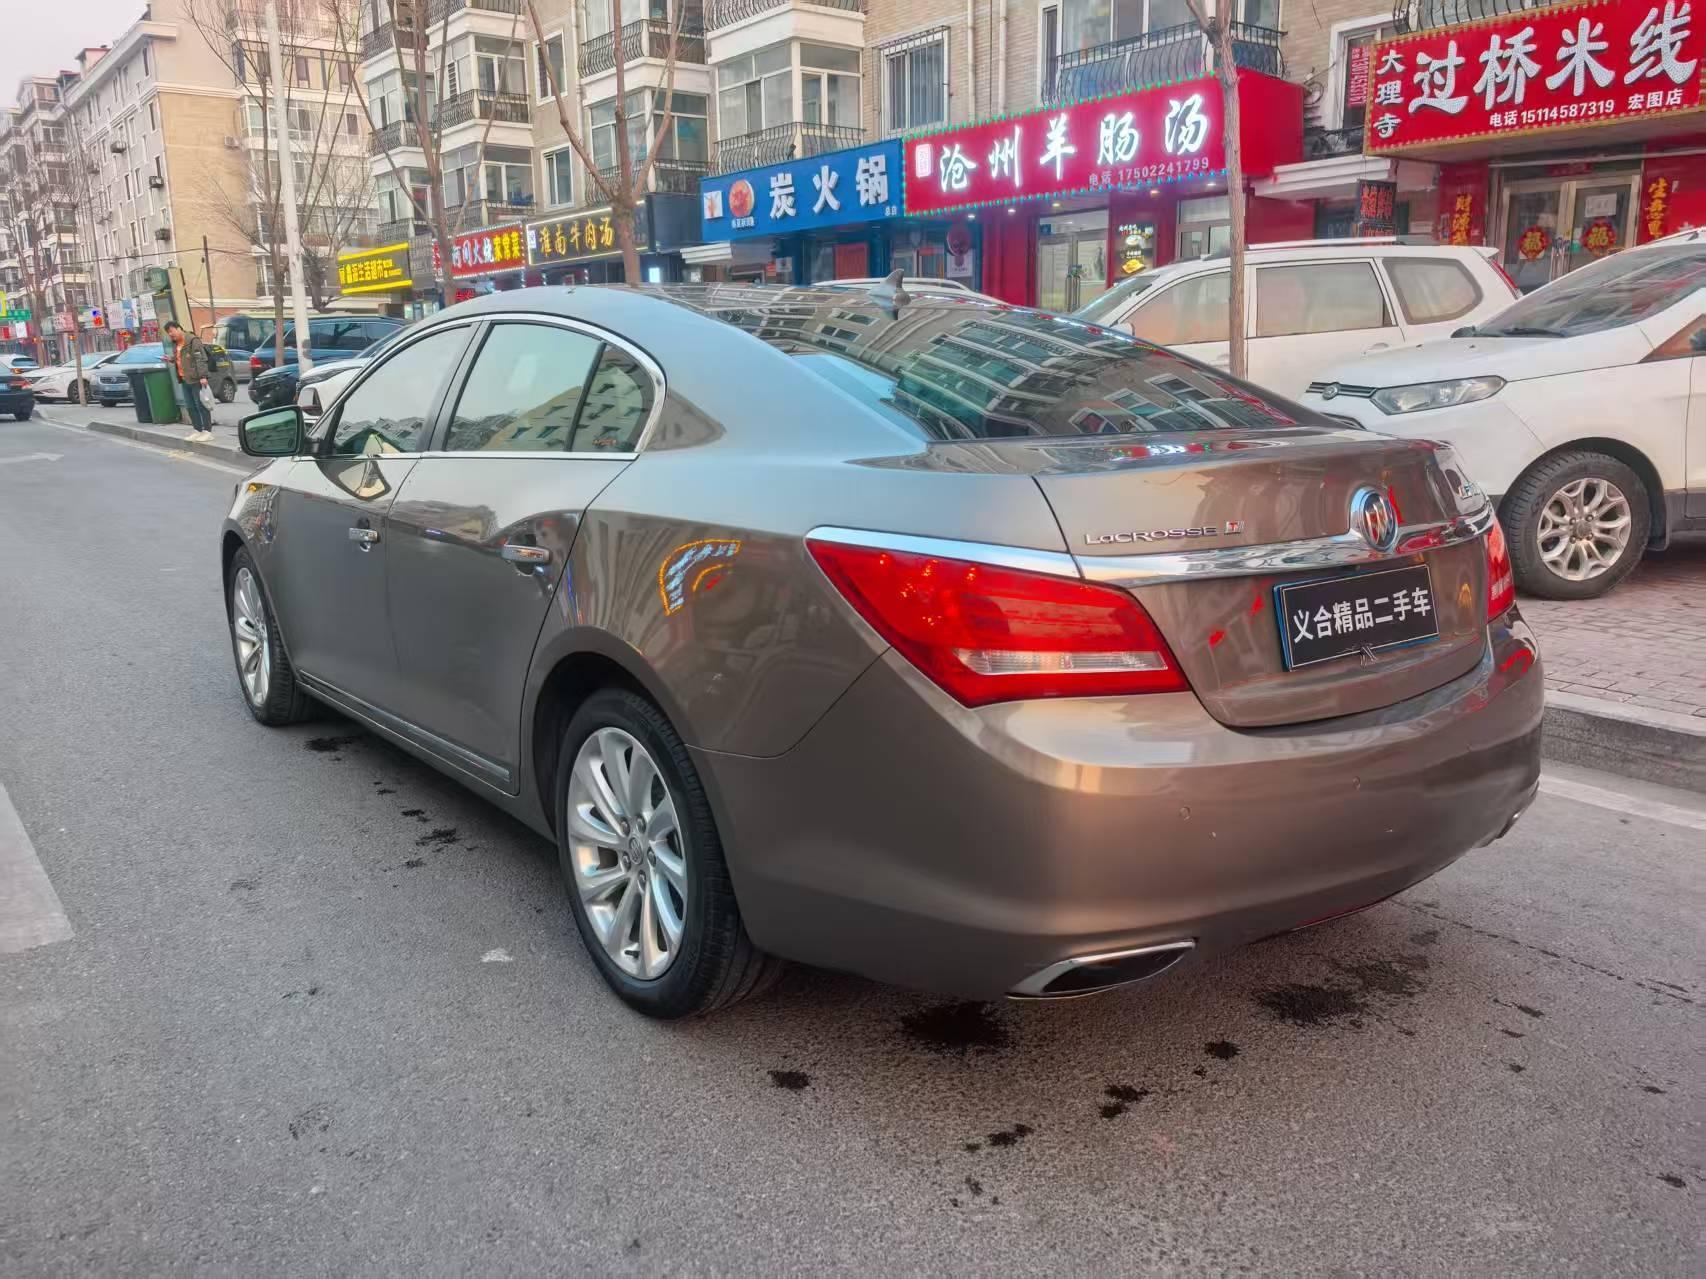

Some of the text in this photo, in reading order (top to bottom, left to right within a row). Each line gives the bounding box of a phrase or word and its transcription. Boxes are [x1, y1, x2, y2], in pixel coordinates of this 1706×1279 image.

[1408, 1, 1697, 115] 过桥米线
[1373, 48, 1406, 139] 大理寺
[1489, 98, 1615, 127] 电话 15114587319
[1627, 88, 1682, 112] 宏图店
[939, 94, 1208, 192] 沧州羊肠汤
[1089, 157, 1209, 187] 电话 17502241799
[769, 154, 889, 220] 炭火锅
[539, 216, 614, 258] 淮南牛肉汤
[1292, 586, 1432, 644] 义合精品二手车
